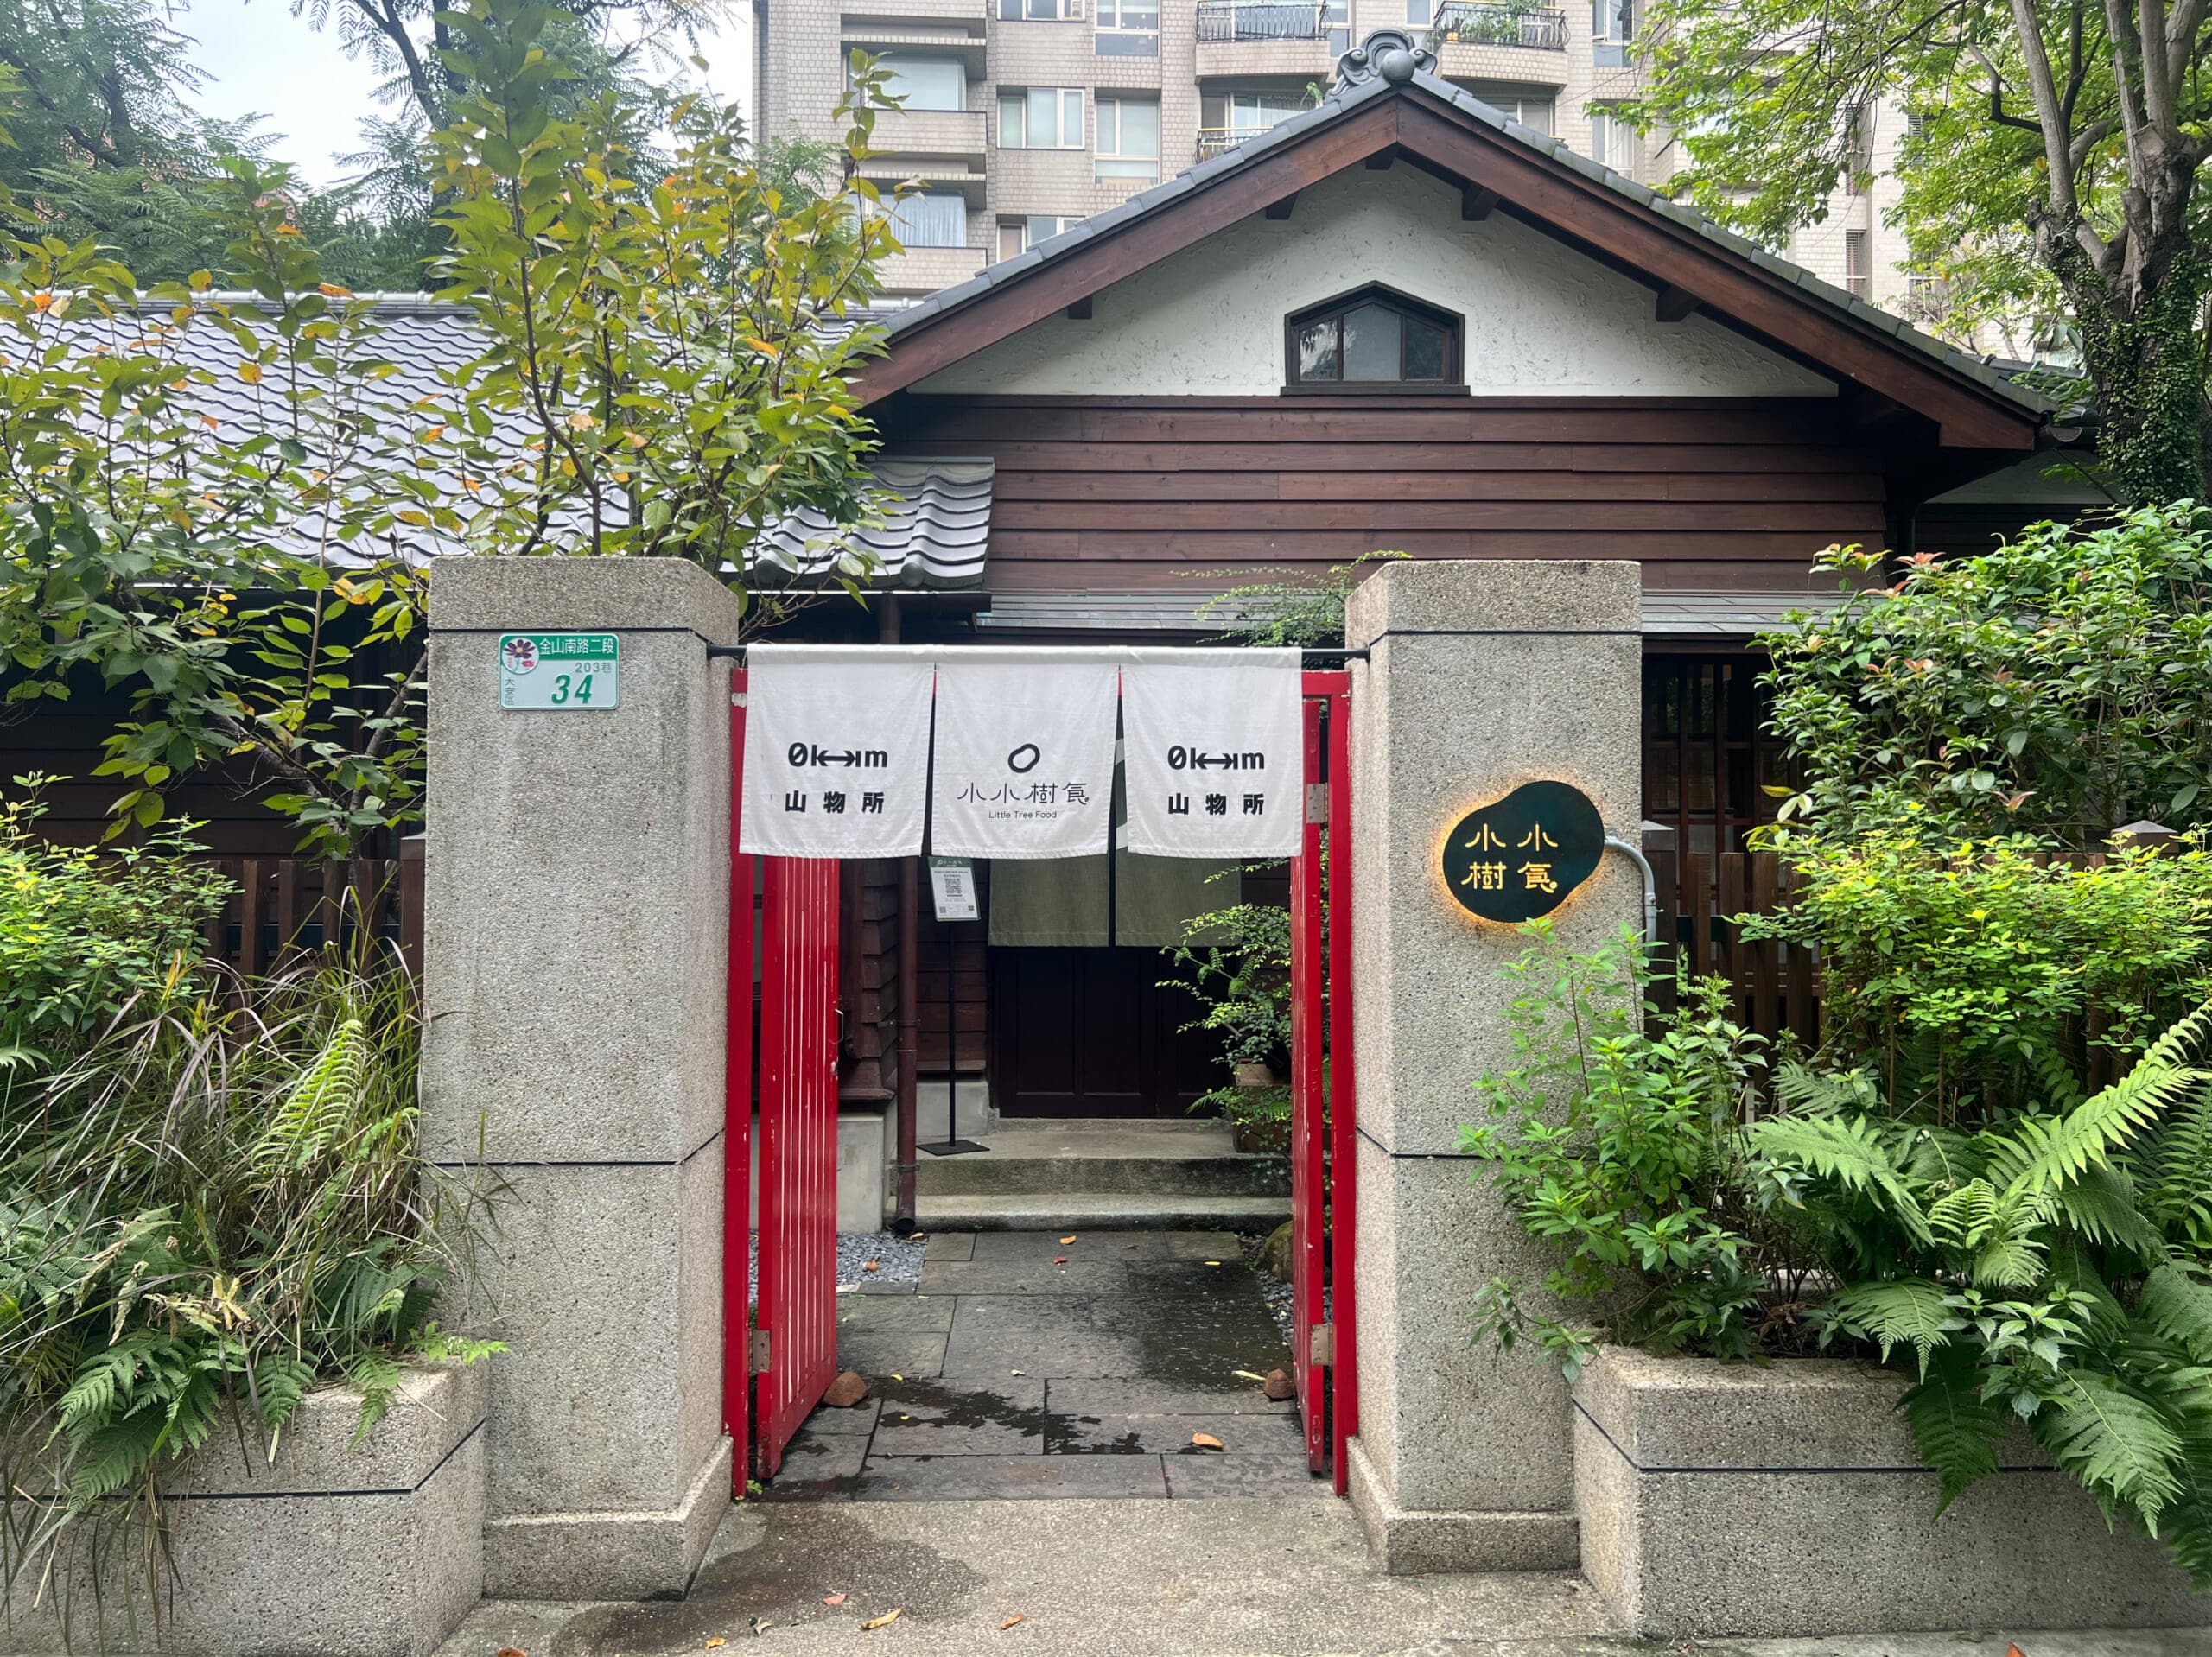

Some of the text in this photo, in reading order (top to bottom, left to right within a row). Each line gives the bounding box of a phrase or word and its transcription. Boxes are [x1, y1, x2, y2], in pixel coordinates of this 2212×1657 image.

[539, 638, 614, 655] 金山南路二段
[575, 662, 613, 673] 203巷
[551, 674, 593, 704] 34
[785, 790, 885, 814] 山物所
[957, 782, 1090, 805] 小小樹食
[1167, 792, 1264, 816] 山物所
[988, 810, 1057, 819] Little Tree Food
[1465, 822, 1559, 852] 小小
[1460, 861, 1558, 894] 樹食
